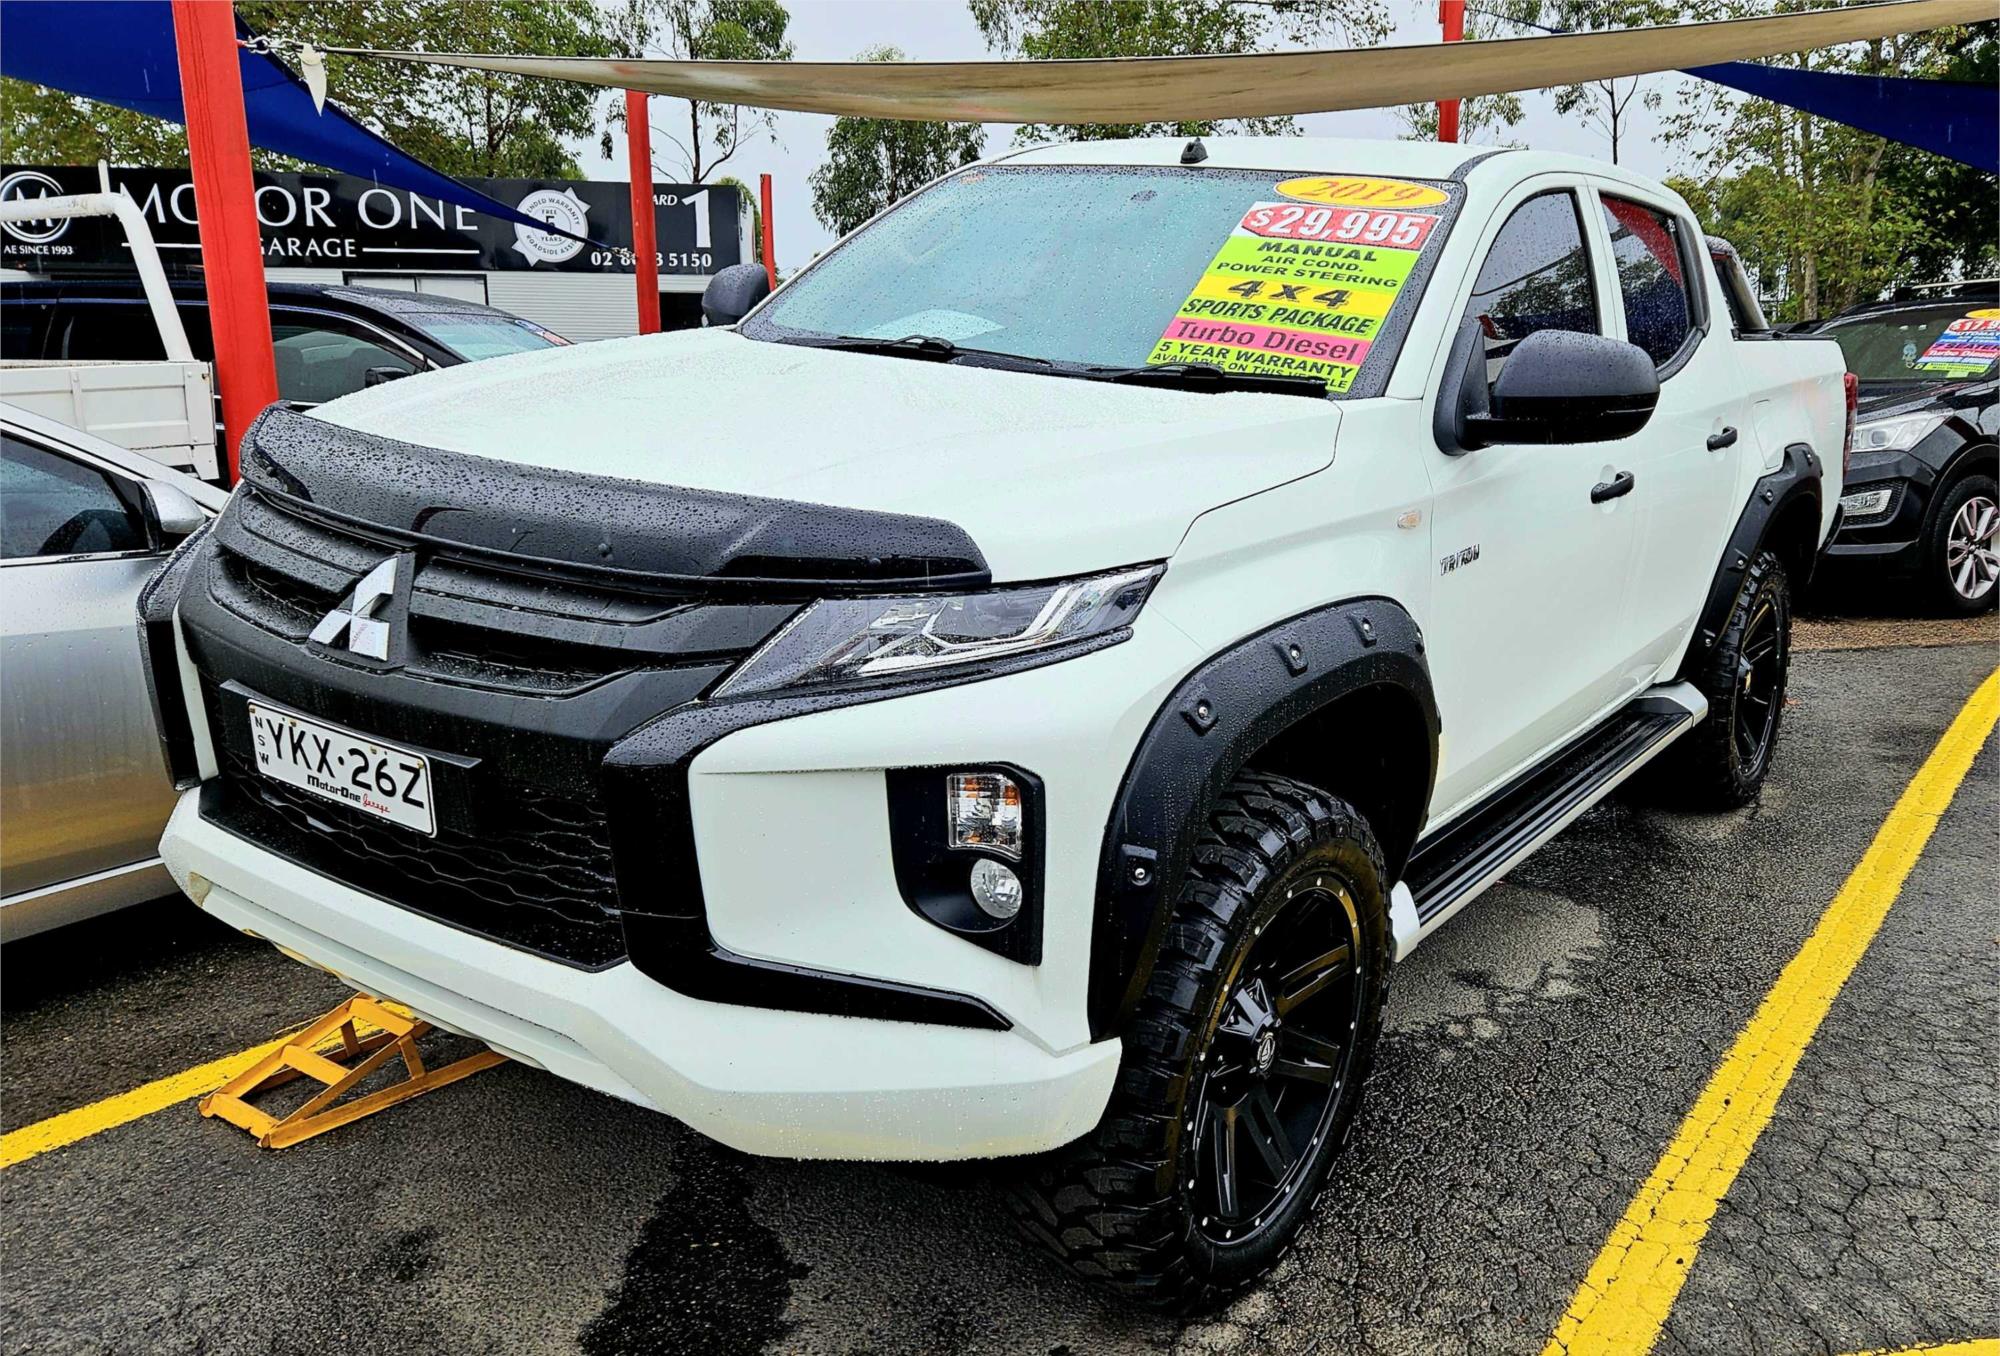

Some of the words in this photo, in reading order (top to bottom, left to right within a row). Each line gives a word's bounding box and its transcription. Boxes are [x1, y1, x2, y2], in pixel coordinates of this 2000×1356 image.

[1298, 180, 1425, 202] 2019
[119, 182, 337, 228] MOOR
[358, 187, 479, 231] ONE
[548, 197, 581, 226] WARRANTY
[652, 193, 679, 207] ARD
[681, 188, 712, 249] 1
[1250, 206, 1426, 245] $29,995
[19, 245, 49, 255] SINCE
[52, 246, 73, 255] 1993
[261, 237, 357, 257] ARAGE
[525, 234, 559, 256] ROADSIDE
[1257, 241, 1377, 262] MANUAL
[590, 251, 613, 266] 02
[668, 252, 712, 267] 5150
[1262, 255, 1296, 265] AIR
[1302, 257, 1364, 272] COND.
[1216, 262, 1287, 275] POWER
[1293, 269, 1398, 288] STEERING
[1182, 299, 1265, 320] SPORTS
[1268, 307, 1375, 334] PACKAGE
[1179, 321, 1256, 346] Turbo
[1263, 329, 1359, 361] Diesel
[1158, 341, 1173, 352] 5
[1179, 343, 1231, 359] YEAR
[1235, 350, 1354, 378] WARRANTY
[1228, 362, 1249, 372] ON
[1440, 543, 1480, 576] TRITON
